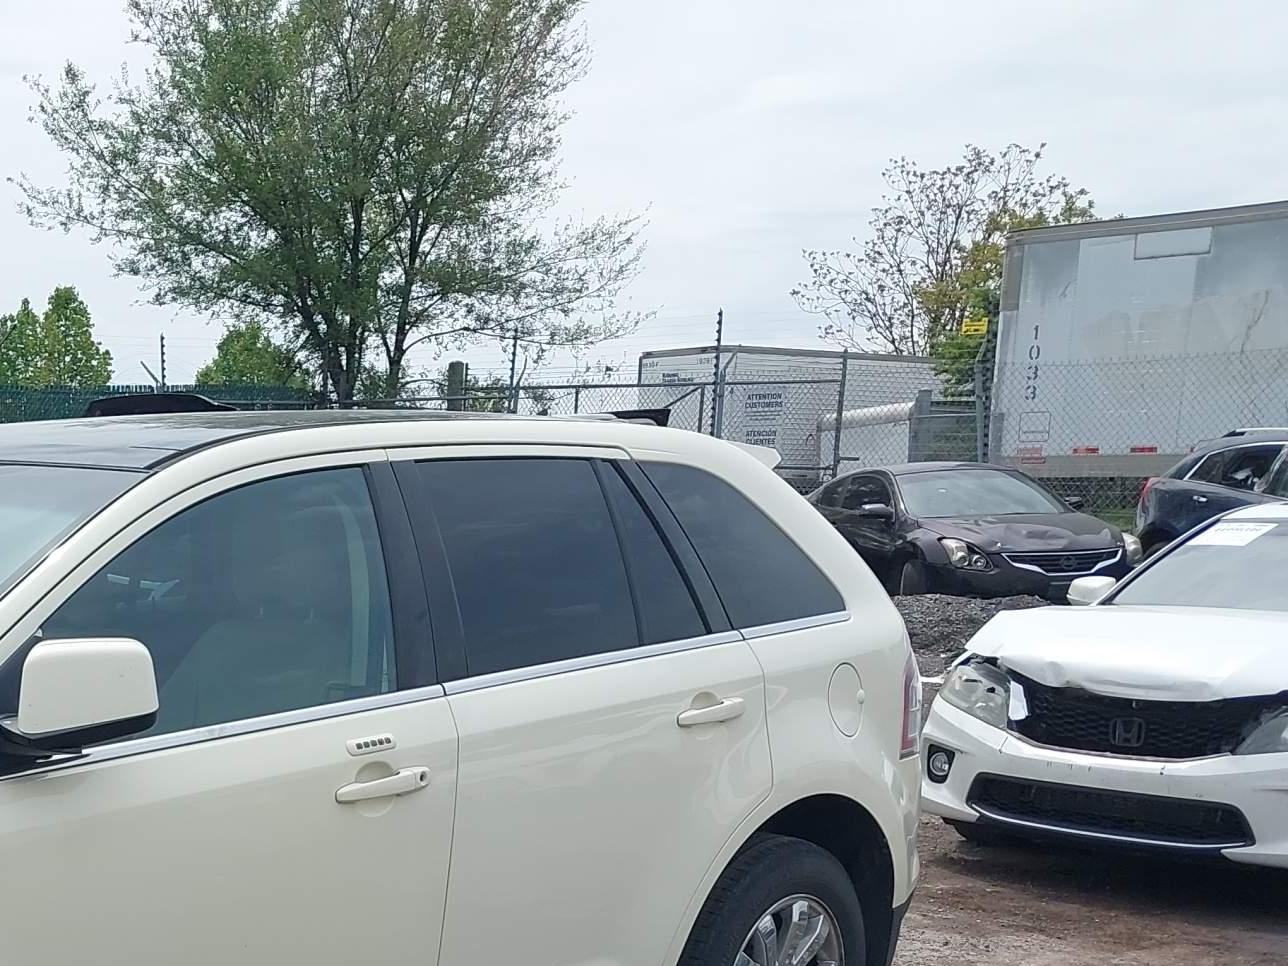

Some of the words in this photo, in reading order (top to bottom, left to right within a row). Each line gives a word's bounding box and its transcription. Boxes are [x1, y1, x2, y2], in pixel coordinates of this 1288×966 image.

[1024, 325, 1041, 401] 1033
[746, 392, 782, 401] ATTENTION
[744, 401, 783, 409] CUSTOMERS
